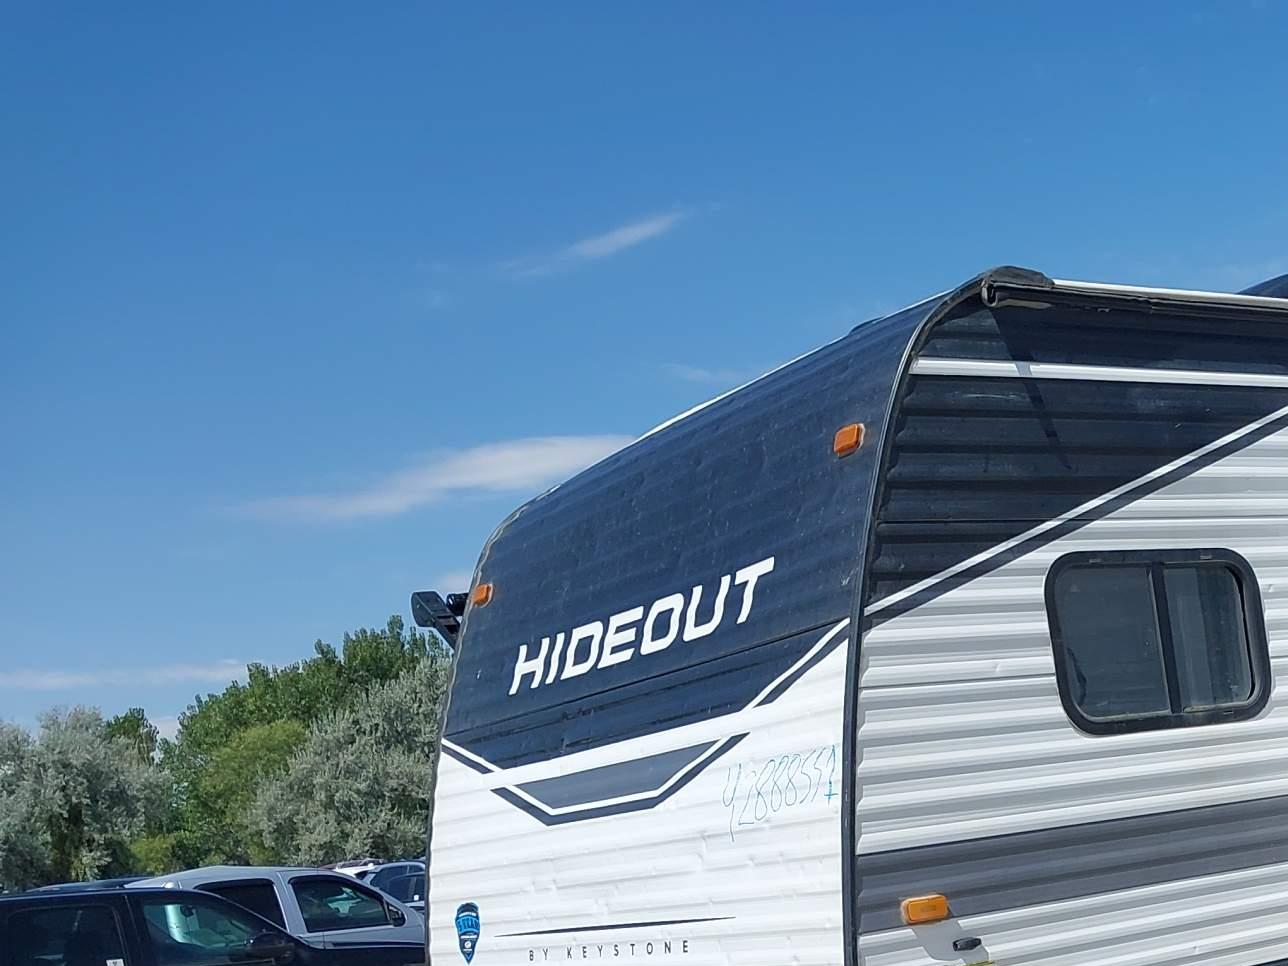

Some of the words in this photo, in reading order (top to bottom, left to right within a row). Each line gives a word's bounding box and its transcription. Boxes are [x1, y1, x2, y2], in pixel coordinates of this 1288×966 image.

[508, 556, 775, 696] HIDEOUT
[528, 948, 549, 962] BY
[566, 940, 689, 959] KEYSTONE
